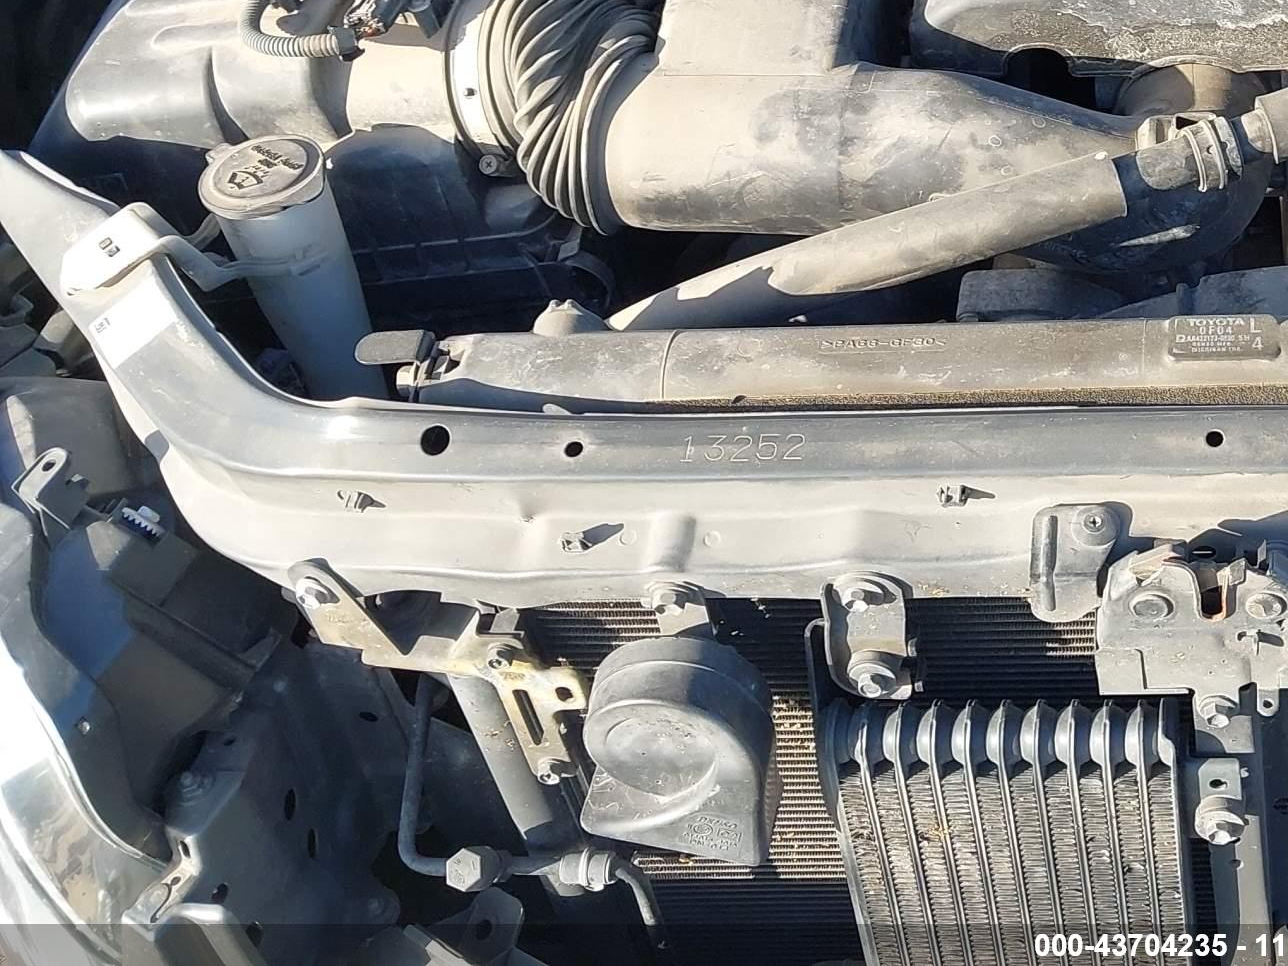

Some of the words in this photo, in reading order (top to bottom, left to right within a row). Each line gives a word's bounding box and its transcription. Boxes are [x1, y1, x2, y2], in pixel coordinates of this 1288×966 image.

[1188, 318, 1245, 327] TOYOTA
[680, 433, 806, 465] 13252
[698, 816, 739, 830] DENSO
